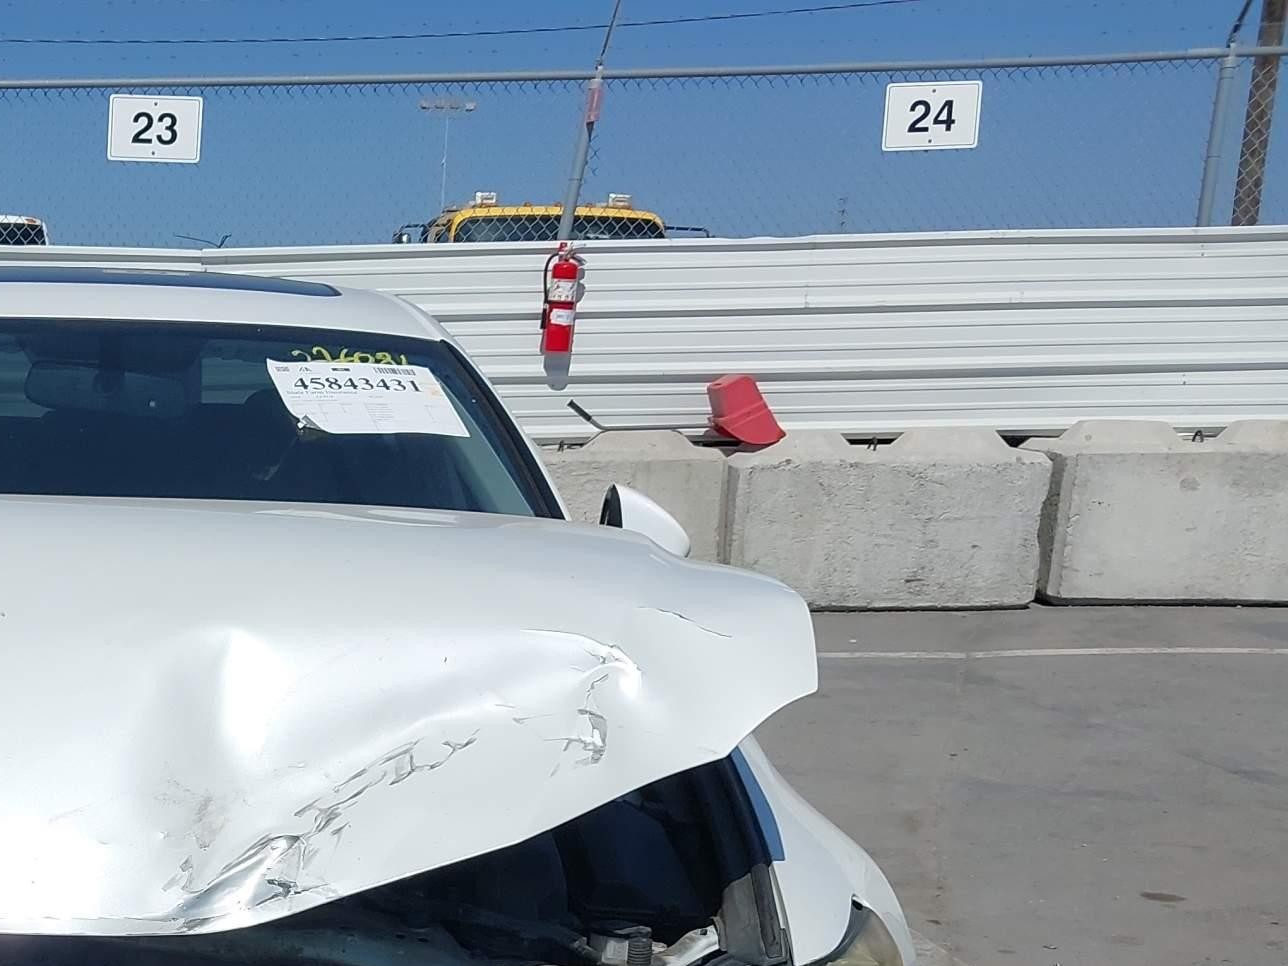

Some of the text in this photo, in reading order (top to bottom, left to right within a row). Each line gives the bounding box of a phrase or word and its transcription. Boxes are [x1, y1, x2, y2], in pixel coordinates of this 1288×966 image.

[131, 111, 178, 146] 23
[907, 99, 956, 133] 24
[294, 377, 422, 393] 45843431
